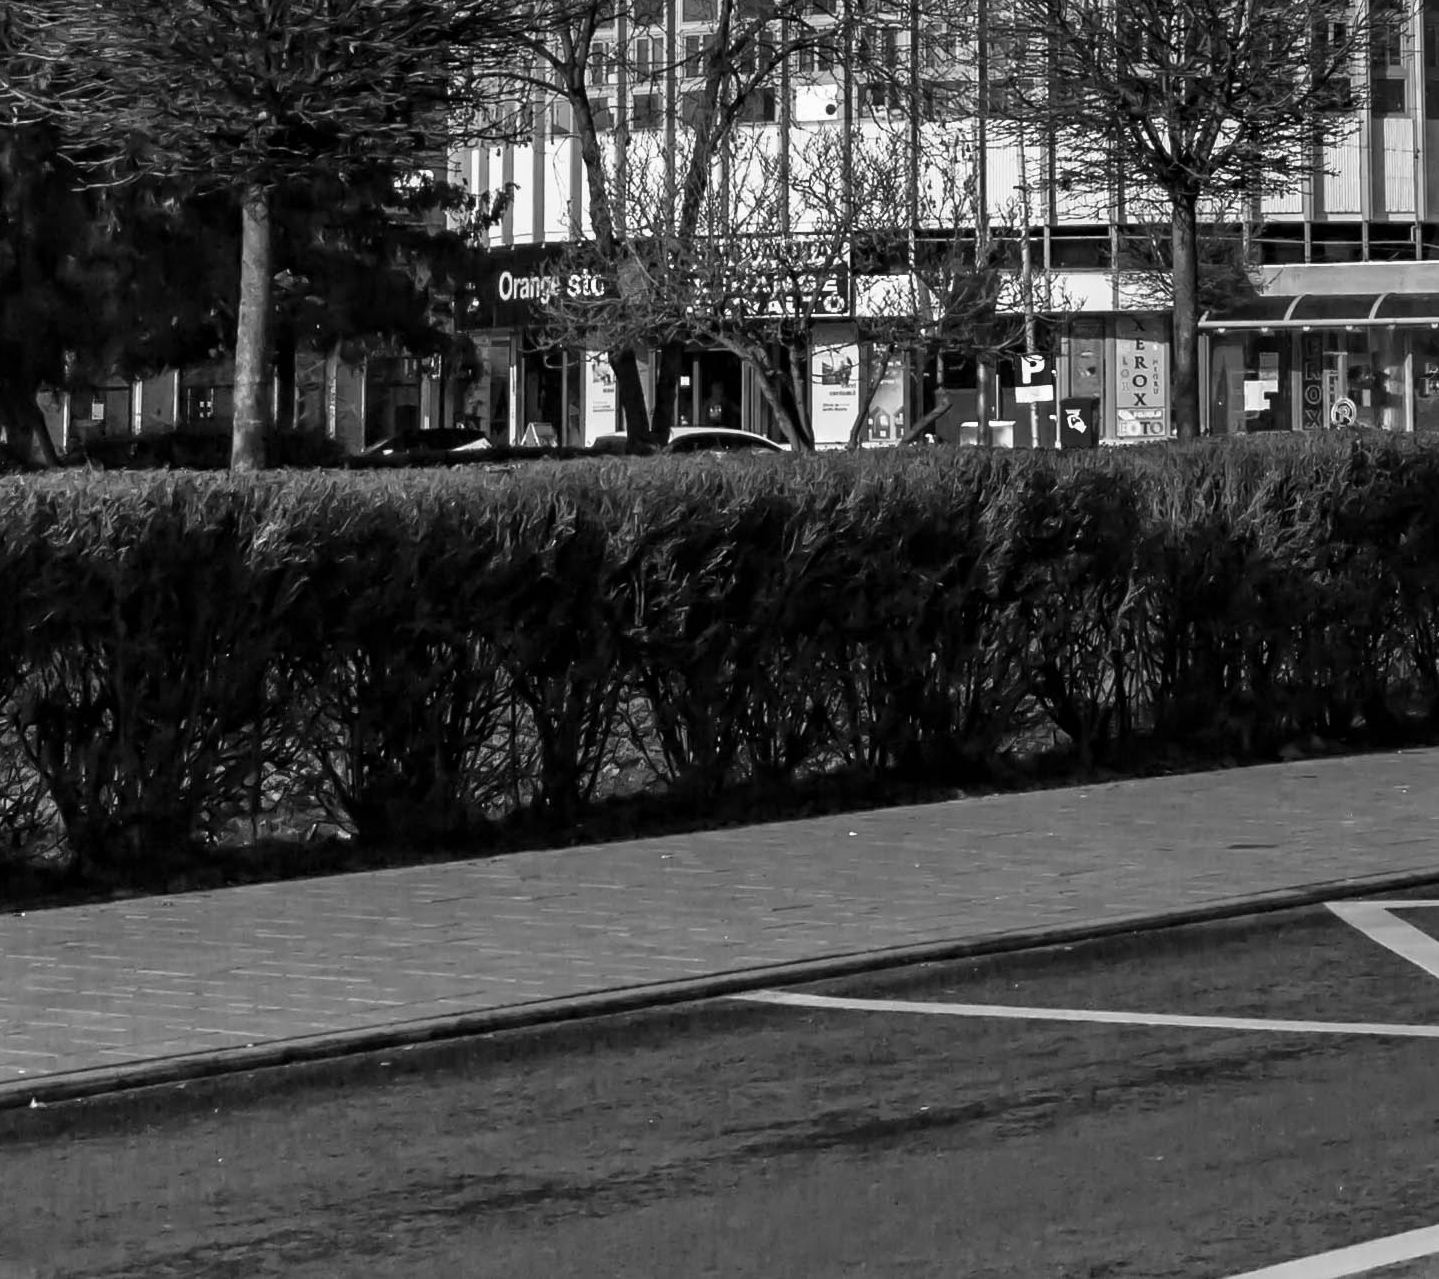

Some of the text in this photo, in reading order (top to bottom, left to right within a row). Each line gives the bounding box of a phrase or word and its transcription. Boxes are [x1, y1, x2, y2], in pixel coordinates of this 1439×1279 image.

[499, 269, 605, 304] Orange sto
[1021, 354, 1046, 385] P
[1131, 318, 1148, 406] XEROX
